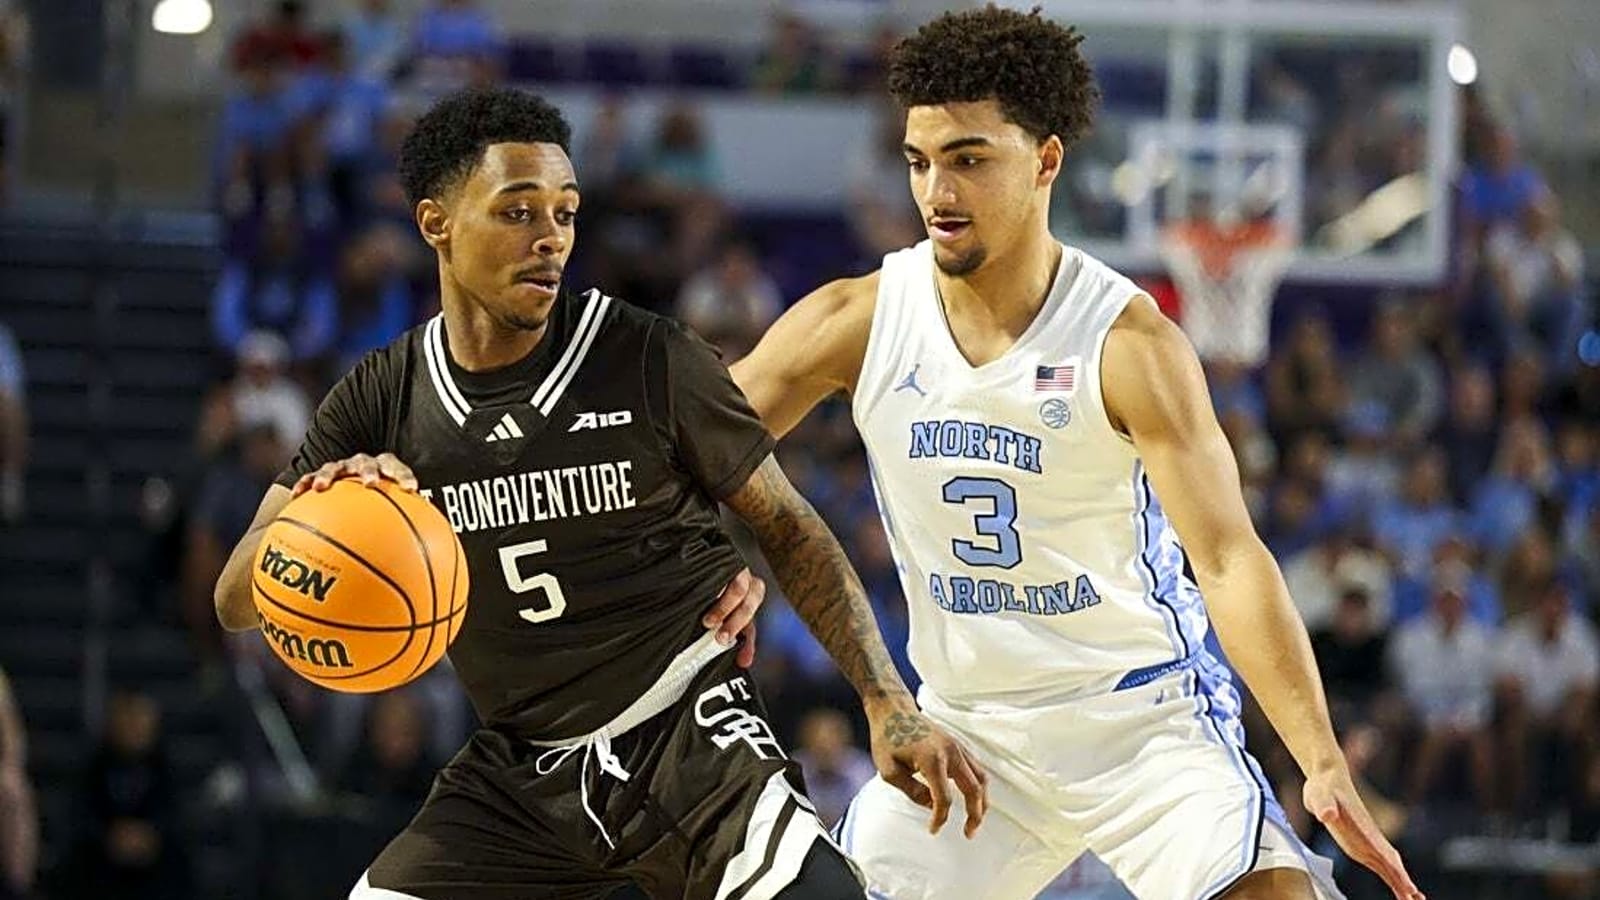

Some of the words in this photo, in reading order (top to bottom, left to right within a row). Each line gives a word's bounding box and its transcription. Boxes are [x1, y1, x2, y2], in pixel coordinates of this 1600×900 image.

[568, 411, 632, 432] A10
[909, 420, 1042, 474] NORTH
[442, 461, 636, 533] BONAVENTURE
[942, 476, 1022, 570] 3
[261, 544, 336, 602] NCAA
[498, 539, 567, 623] 5
[930, 573, 1101, 615] AROLINA
[259, 612, 353, 667] Wilso
